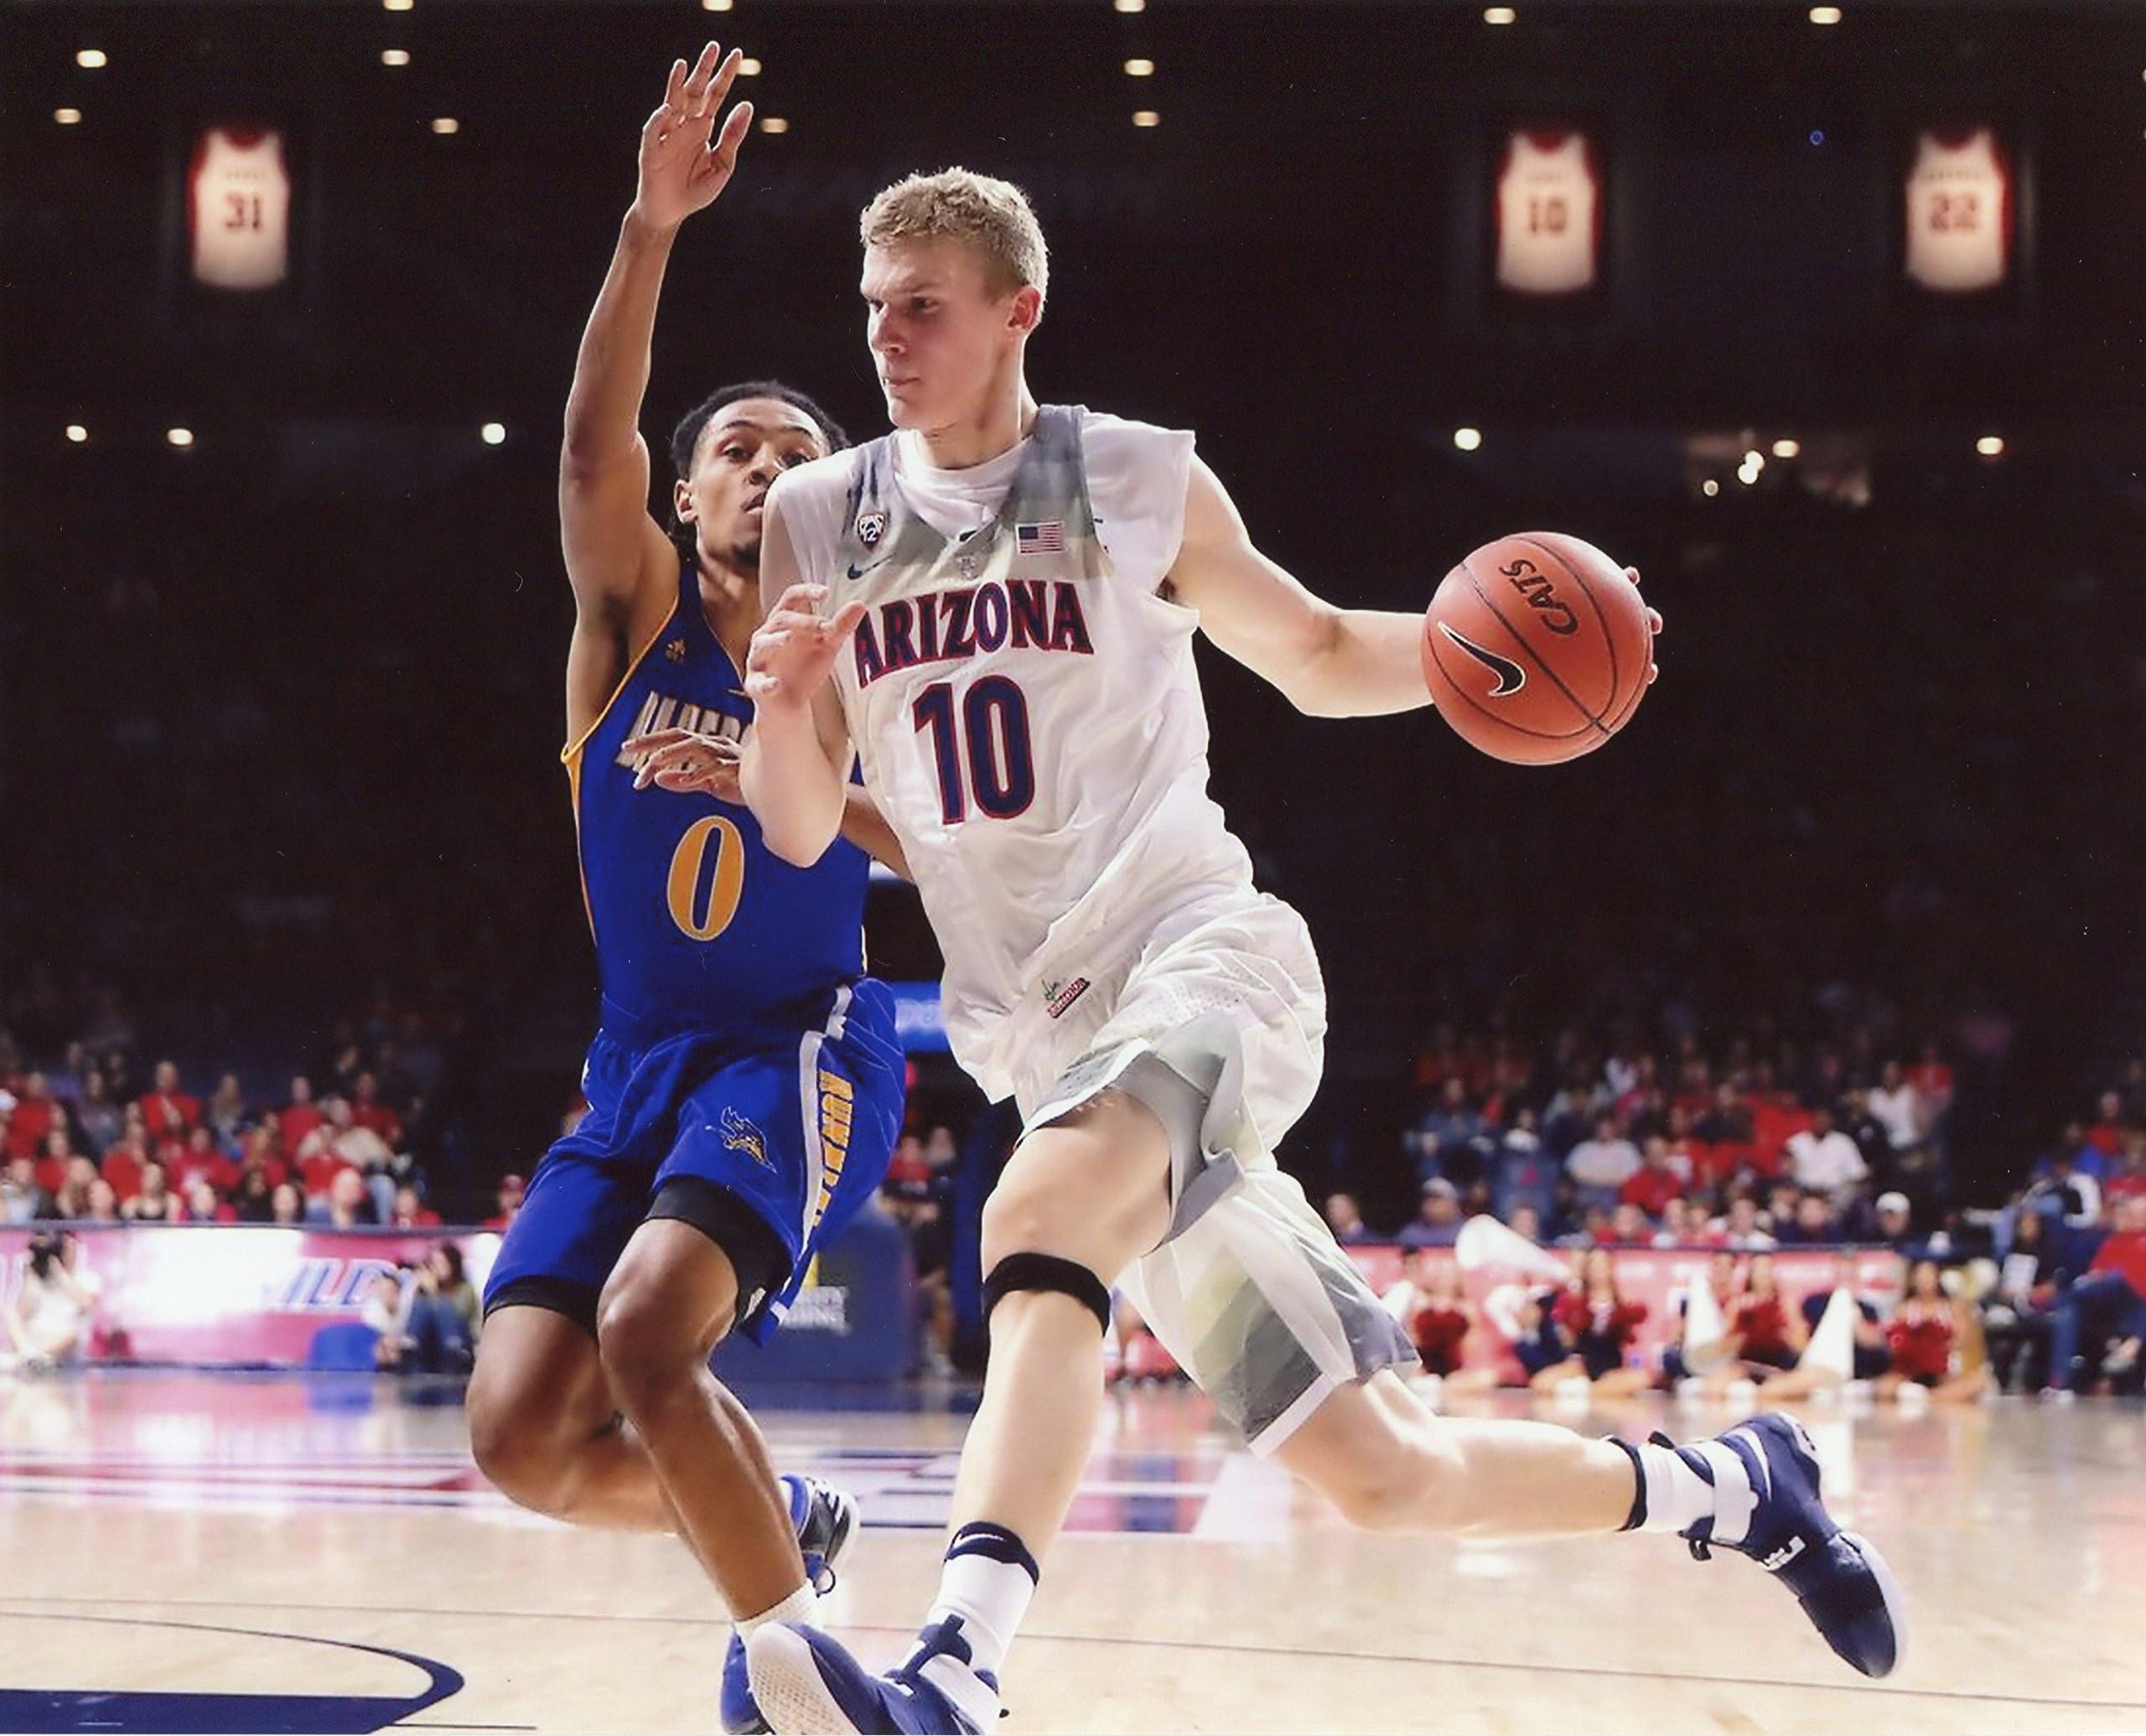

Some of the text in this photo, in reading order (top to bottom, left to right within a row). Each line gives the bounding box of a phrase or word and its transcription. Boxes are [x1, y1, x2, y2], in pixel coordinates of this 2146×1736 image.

[224, 191, 262, 232] 31
[853, 578, 1094, 689] ARIZONA
[1498, 559, 1578, 635] CATS
[911, 675, 1035, 825] 10
[666, 815, 744, 942] 0
